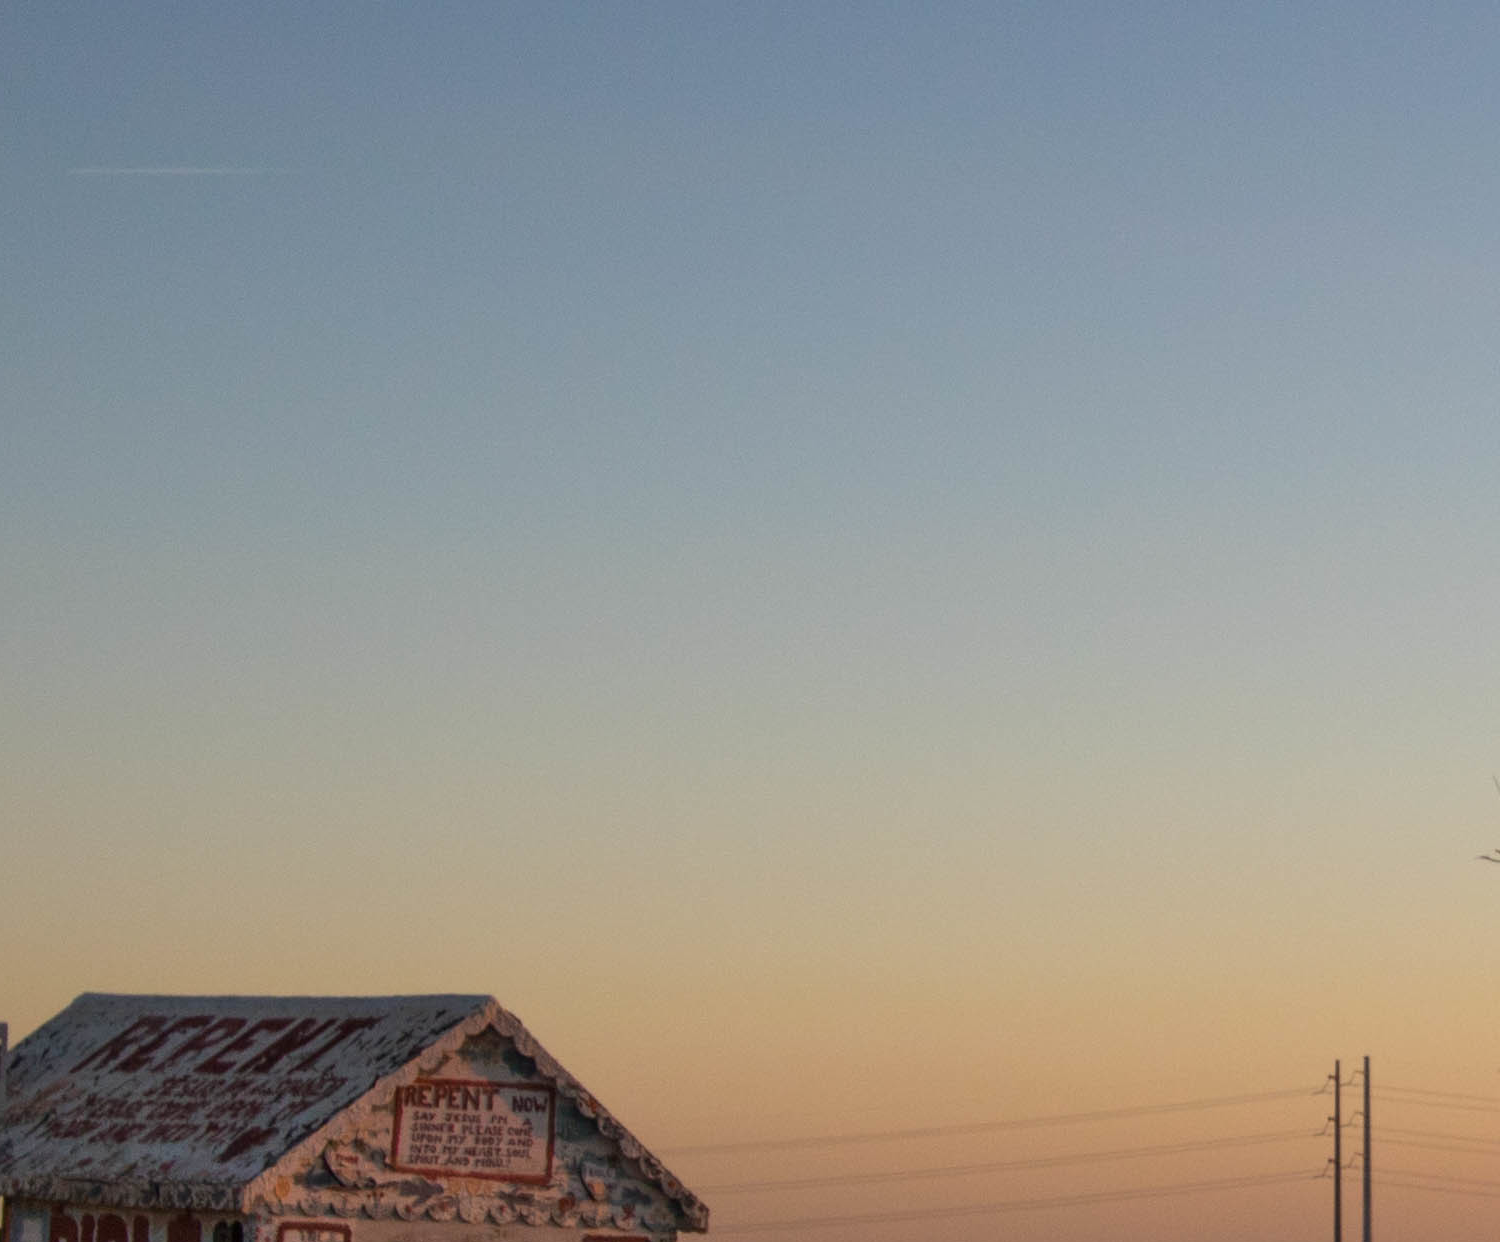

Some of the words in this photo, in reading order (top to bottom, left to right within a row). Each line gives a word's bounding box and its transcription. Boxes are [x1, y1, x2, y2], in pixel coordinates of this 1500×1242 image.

[71, 1016, 385, 1074] REPENT
[403, 1085, 500, 1110] REPENT
[512, 1095, 548, 1113] NOW
[462, 1124, 503, 1136] PLEASE
[411, 1133, 442, 1144] UPON
[447, 1135, 465, 1145] MY
[508, 1137, 533, 1147] AND
[464, 1147, 501, 1157] HEART
